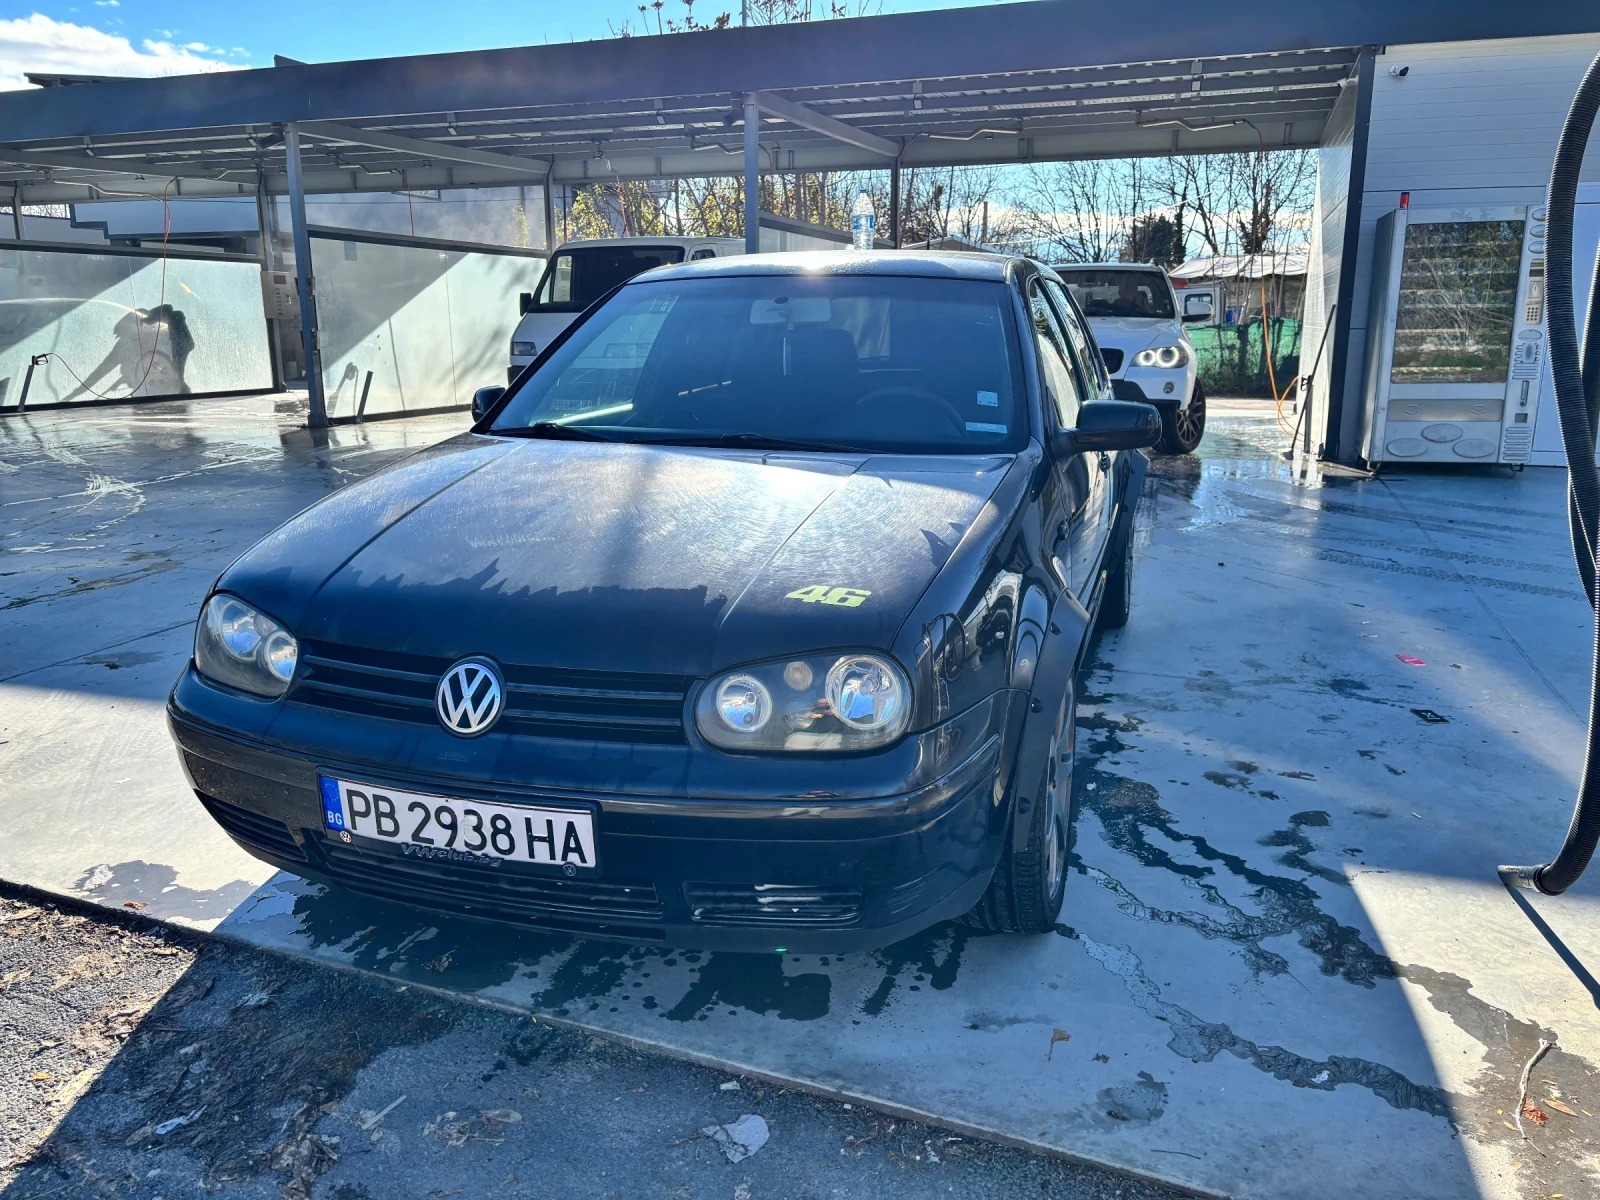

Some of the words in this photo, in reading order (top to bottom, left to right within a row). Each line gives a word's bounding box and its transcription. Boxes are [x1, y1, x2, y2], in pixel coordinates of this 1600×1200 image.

[784, 584, 872, 608] 46
[327, 810, 343, 825] BG
[346, 789, 400, 838] PB
[407, 801, 516, 856] 2938
[524, 816, 588, 864] HA
